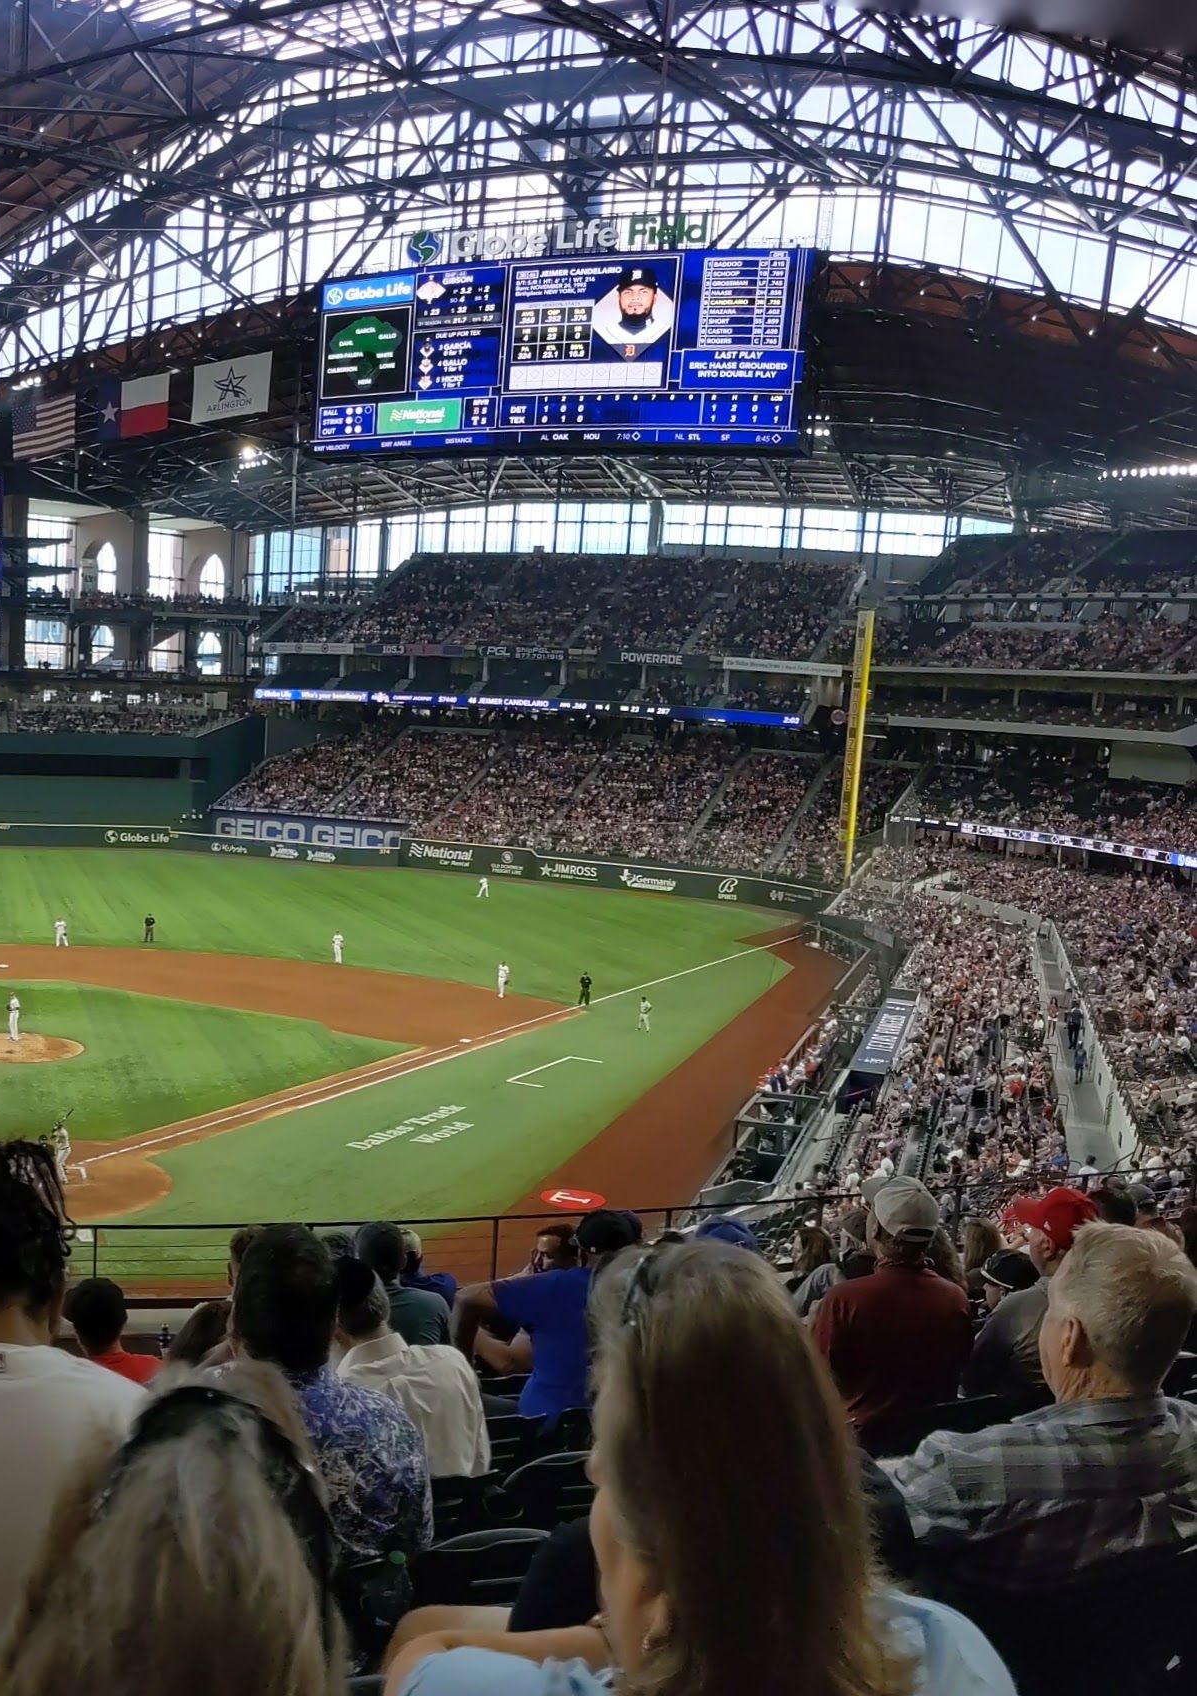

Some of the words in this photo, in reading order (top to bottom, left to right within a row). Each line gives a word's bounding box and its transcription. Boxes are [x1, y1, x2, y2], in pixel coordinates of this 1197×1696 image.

[449, 228, 549, 259] Globe
[554, 217, 618, 250] Life
[627, 213, 709, 247] Field
[539, 269, 569, 278] JEIMER
[569, 266, 622, 276] CANDELARIO
[442, 275, 474, 286] GIBSON
[344, 286, 385, 301] Globe
[386, 283, 412, 297] Life
[378, 333, 397, 341] GALLO
[738, 351, 763, 359] PLAY
[442, 359, 468, 367] GALLO
[738, 362, 788, 370] GROUNDED
[441, 375, 464, 384] HICKS
[205, 400, 253, 415] ARLINGTON
[322, 408, 338, 416] BALL
[509, 406, 527, 414] DET
[403, 407, 446, 421] National
[322, 418, 344, 426] STRIKE
[509, 416, 525, 424] TEX
[322, 428, 336, 436] OUT
[552, 433, 569, 441] OAK
[687, 433, 701, 441] STL
[720, 434, 731, 442] SF
[486, 646, 511, 657] PGL
[619, 651, 683, 665] POWERADE
[264, 690, 280, 699] Globe
[280, 690, 292, 699] Life
[318, 692, 331, 701] your
[467, 696, 478, 704] 46
[477, 697, 503, 706] JEIMER
[504, 698, 549, 708] CANDELARIO
[630, 705, 640, 713] 23
[215, 817, 305, 843] GEICO
[119, 831, 150, 843] Globe
[151, 832, 171, 844] Life
[222, 843, 248, 854] Kubota
[423, 844, 474, 862] National
[450, 860, 471, 868] Rental
[634, 875, 677, 888] Germania
[717, 892, 739, 901] SPORTS
[344, 1124, 415, 1151] Dallas
[402, 1104, 468, 1126] Truck
[409, 1120, 476, 1144] World
